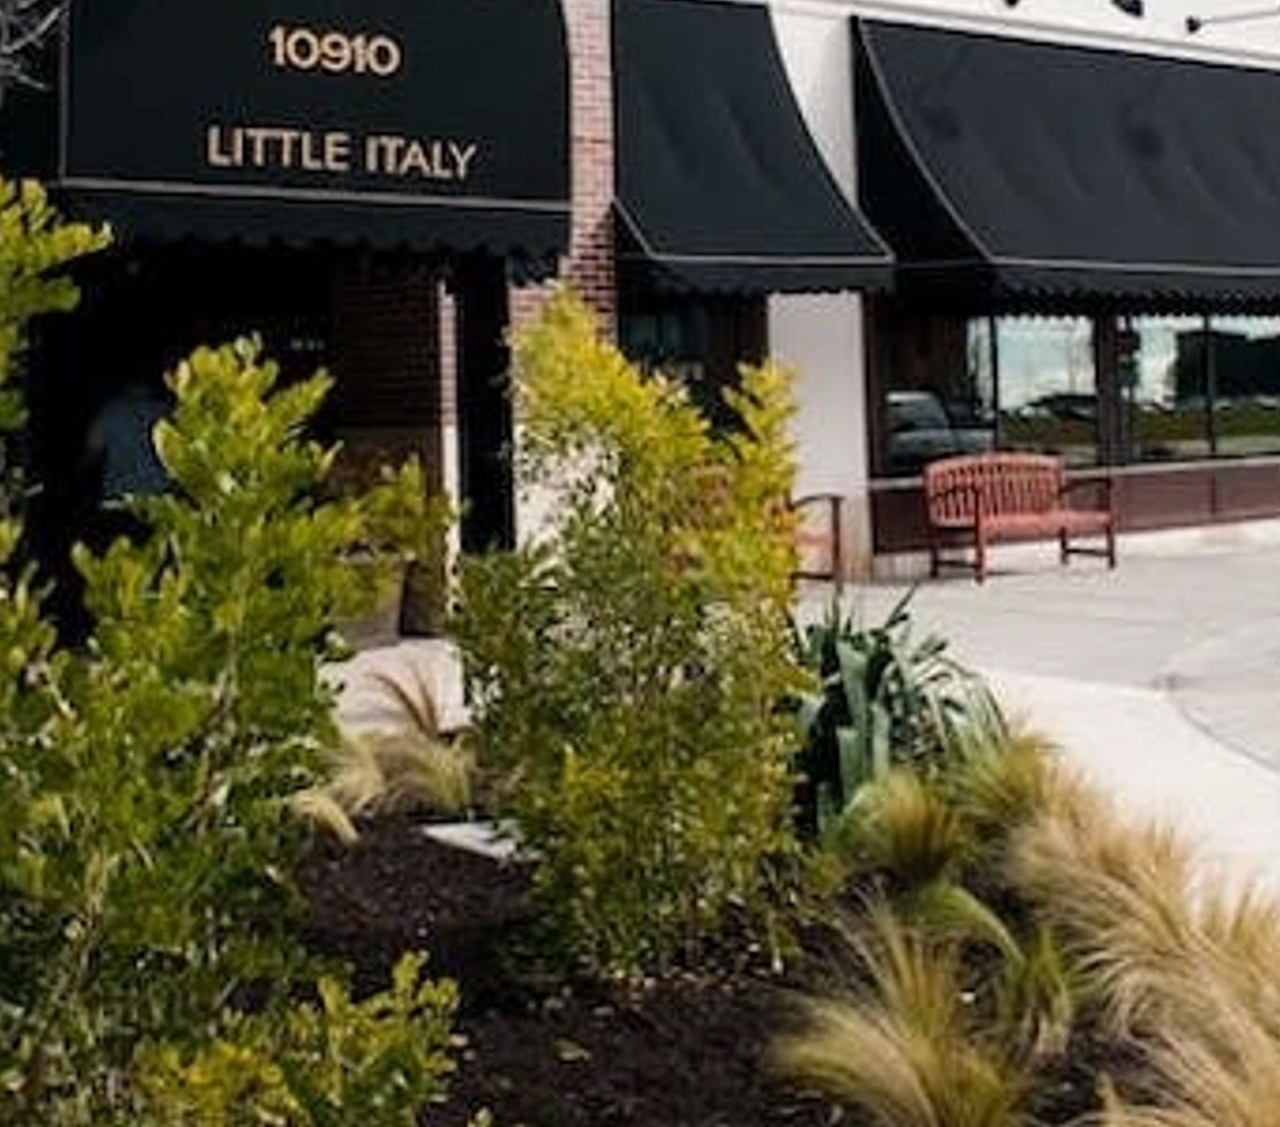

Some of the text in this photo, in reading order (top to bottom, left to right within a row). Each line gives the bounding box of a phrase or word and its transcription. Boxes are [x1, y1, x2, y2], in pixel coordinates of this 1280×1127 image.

[267, 25, 401, 75] 10910
[207, 125, 477, 180] LITTLE ITALY
